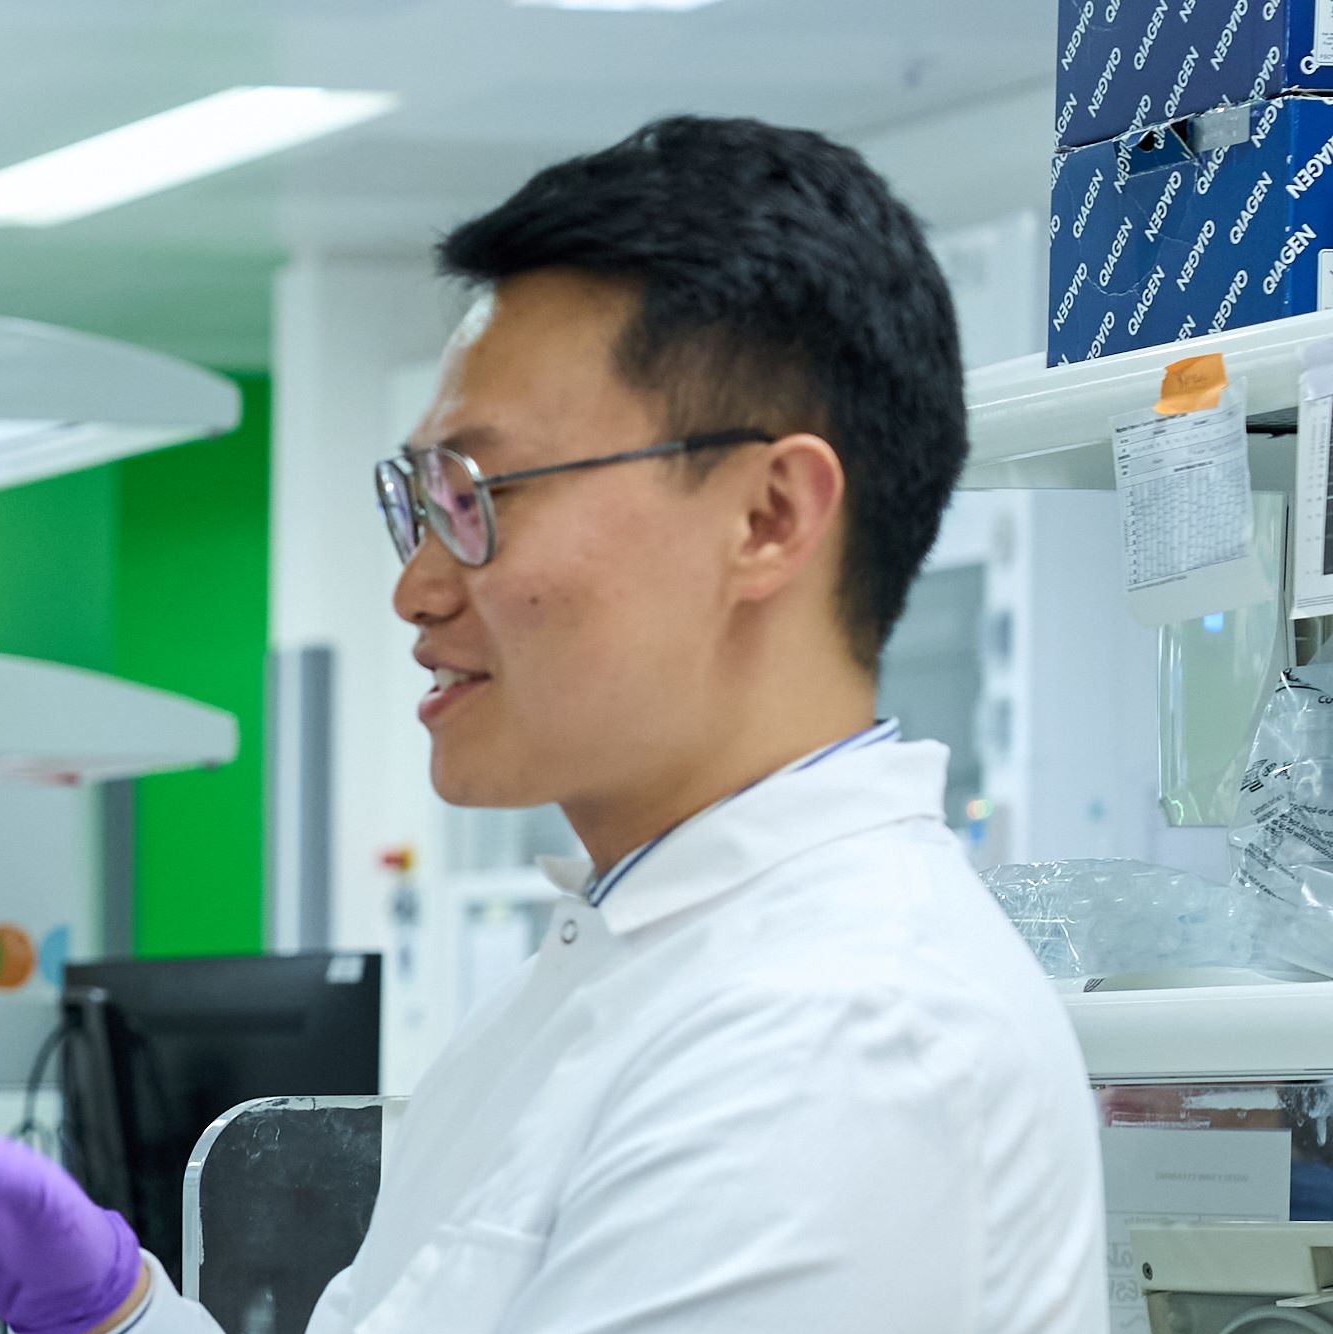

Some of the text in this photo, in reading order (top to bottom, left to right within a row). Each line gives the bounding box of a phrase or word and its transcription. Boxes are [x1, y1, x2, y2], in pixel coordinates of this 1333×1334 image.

[1061, 0, 1094, 71] QIAGEN
[1134, 0, 1169, 70] QIAGEN
[1210, 0, 1249, 71] QIAGEN
[1087, 47, 1122, 118] QIAGEN
[1165, 46, 1200, 118] QIAGEN
[1249, 46, 1280, 100] QIAG
[1251, 97, 1284, 148] AGEN
[1197, 145, 1230, 194] QIAG
[1285, 136, 1333, 199] IAGEN
[1073, 168, 1104, 238] QIAGEN
[1145, 171, 1182, 242] QIAGEN
[1230, 171, 1273, 244] QIAGEN
[1099, 216, 1133, 287] QIAGEN
[1176, 220, 1215, 292] QIAGEN
[1263, 223, 1317, 294] QIAGEN
[1053, 263, 1088, 331] QIAGEN
[1128, 265, 1165, 335] QIAGEN
[1086, 311, 1115, 359] QIAG
